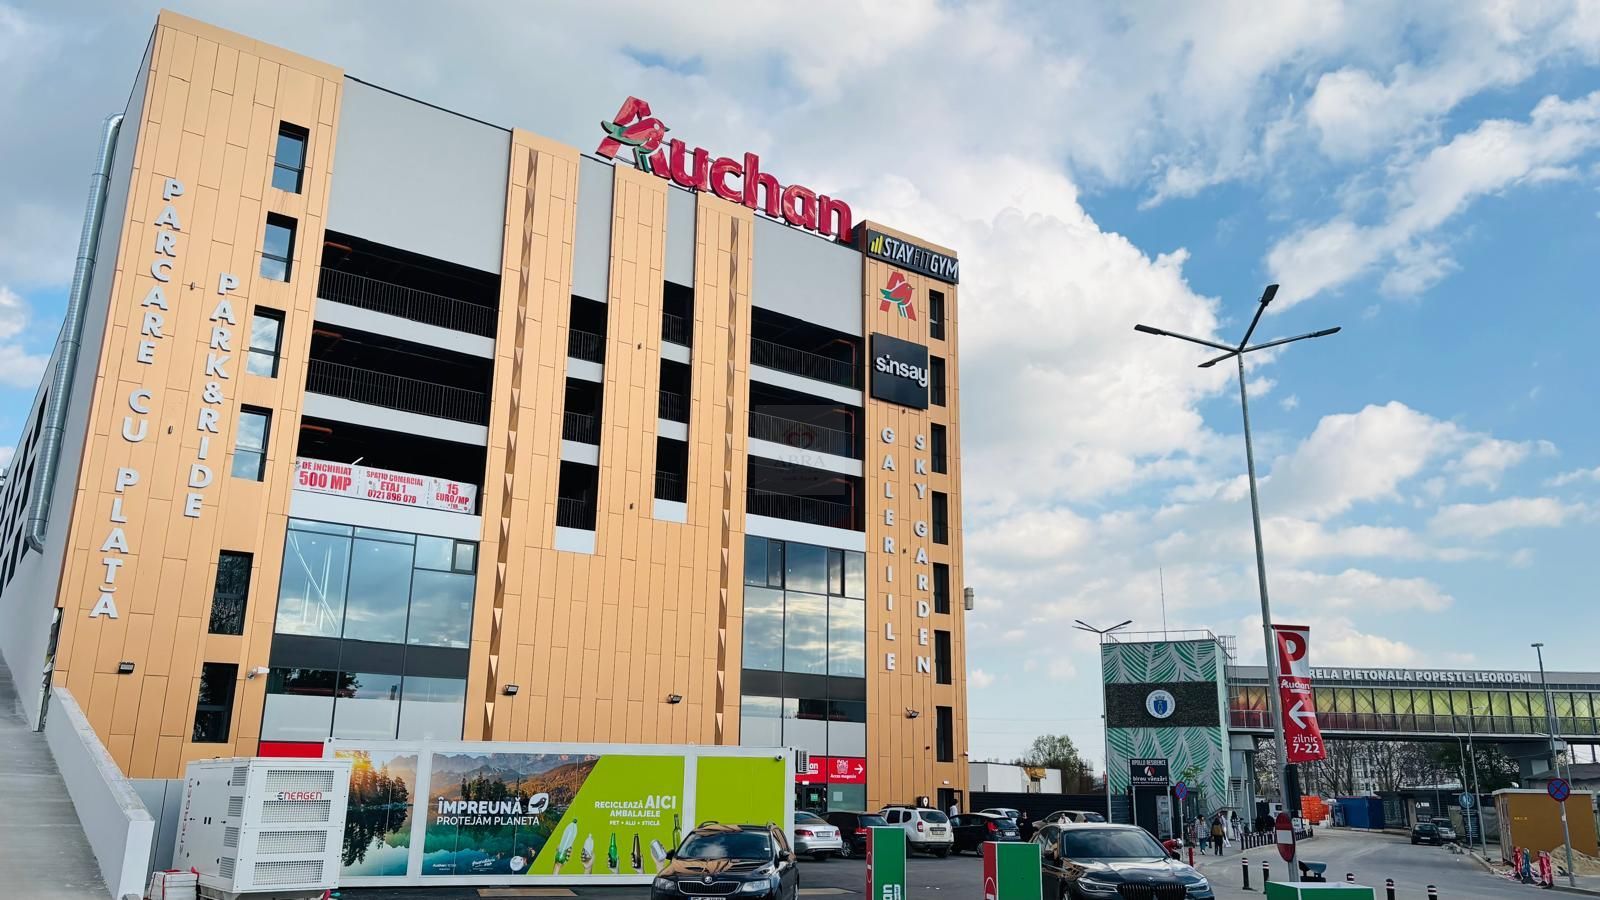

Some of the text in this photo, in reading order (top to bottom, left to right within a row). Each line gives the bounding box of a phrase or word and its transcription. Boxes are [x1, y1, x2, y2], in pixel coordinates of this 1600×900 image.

[595, 96, 852, 243] Auchan
[876, 354, 928, 388] sinsay
[88, 178, 184, 618] PARCARE CU PLATĂ
[184, 271, 240, 518] PARK&RIDE
[302, 461, 312, 470] DE
[299, 471, 352, 491] 500 MP
[389, 474, 424, 486] COMERCIAL
[380, 481, 407, 494] ETAJ 1
[447, 484, 459, 496] 15
[367, 489, 385, 500] 0721
[435, 492, 470, 505] EURO/MP
[881, 427, 895, 671] GALERIILE
[914, 434, 930, 674] SKY GARDEN
[1278, 631, 1306, 675] P
[1343, 669, 1412, 681] PIETONALA
[1281, 679, 1310, 690] Auchan
[1293, 734, 1318, 743] zilnic
[1293, 744, 1320, 753] 7-22
[277, 791, 322, 801] ENERGEN
[645, 794, 677, 810] AICI
[437, 796, 523, 815] ÎMPREUNĂ
[436, 814, 540, 826] PROTEJĂM PLANETA
[610, 809, 661, 818] AMBALAJELE
